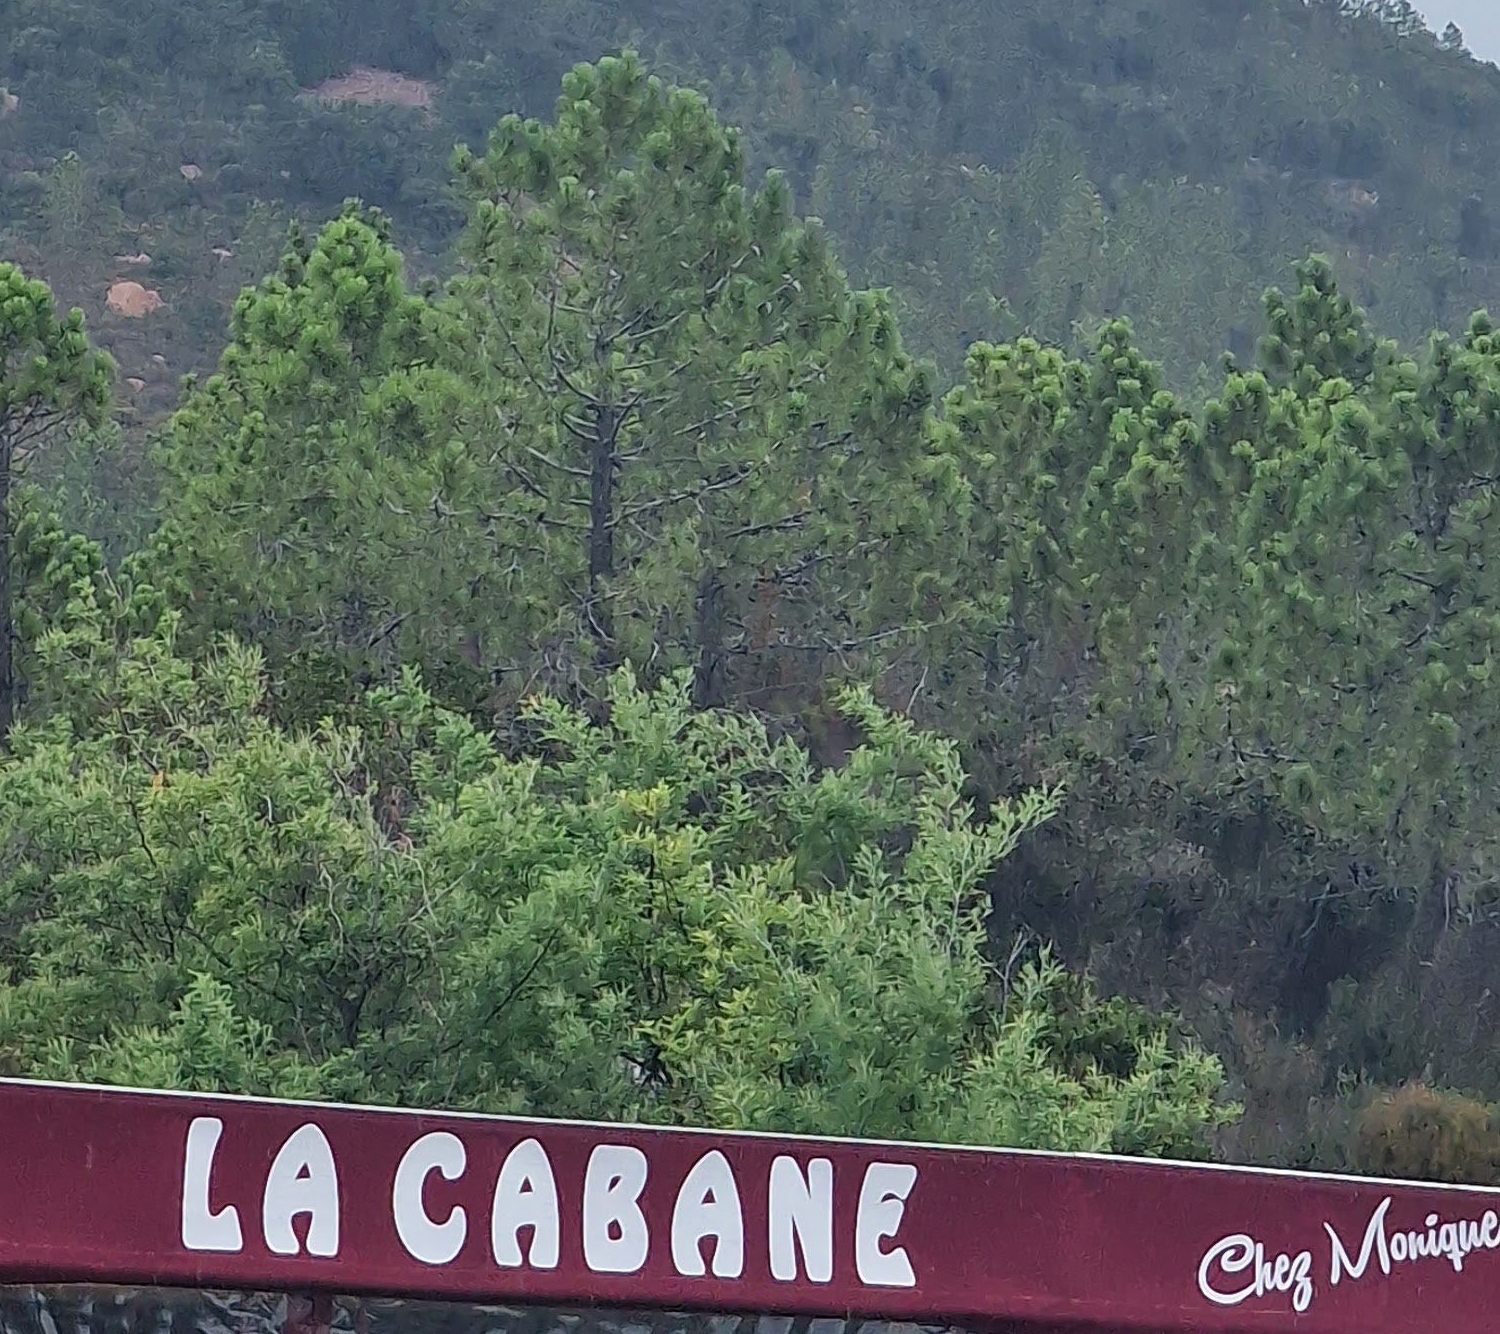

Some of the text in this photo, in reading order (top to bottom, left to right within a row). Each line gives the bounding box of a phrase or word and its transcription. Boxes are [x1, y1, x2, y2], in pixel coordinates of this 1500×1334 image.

[182, 1117, 919, 1288] LA CABANE
[1198, 1196, 1500, 1312] Chez Monique
